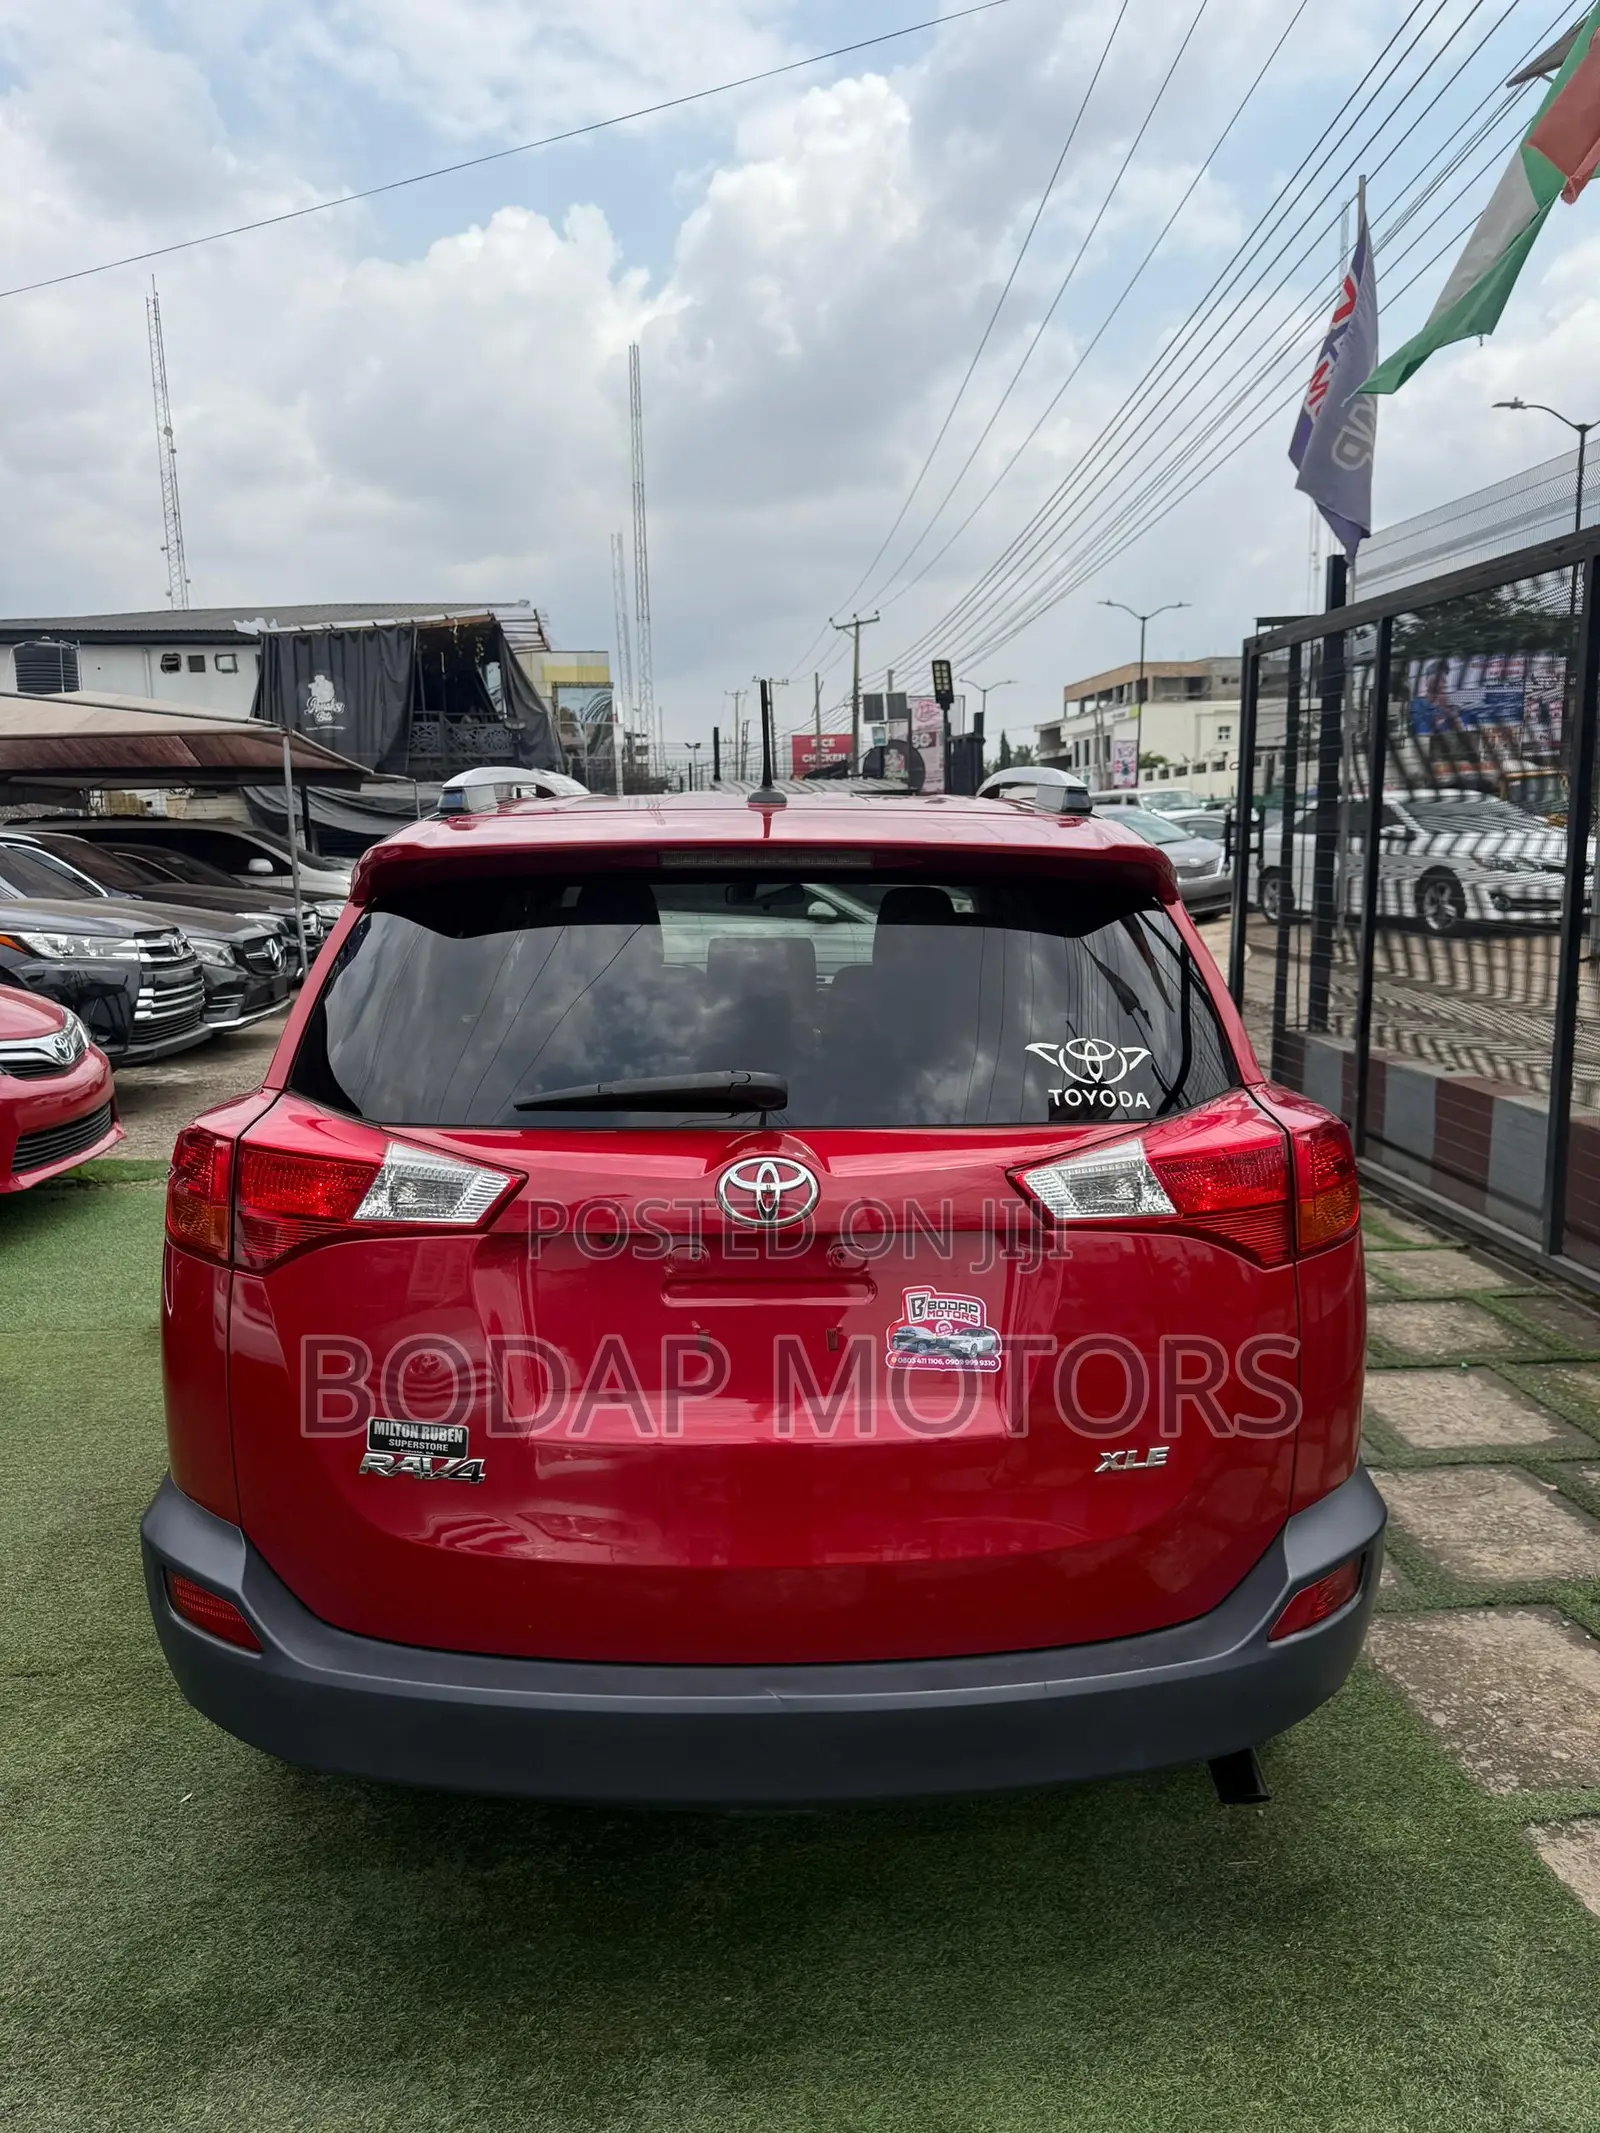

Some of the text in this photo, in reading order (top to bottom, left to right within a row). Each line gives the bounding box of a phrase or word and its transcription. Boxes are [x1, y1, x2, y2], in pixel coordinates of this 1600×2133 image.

[811, 738, 836, 748] RCE
[802, 753, 846, 763] CHCKEN
[1048, 1088, 1151, 1109] TOYODA
[927, 1300, 979, 1314] BODAP
[927, 1310, 979, 1325] MOTORS
[374, 1421, 464, 1444] MILTON RUBEN
[388, 1438, 449, 1452] SUPERSTORE
[1094, 1446, 1171, 1473] XLE
[359, 1453, 487, 1484] RAV4
